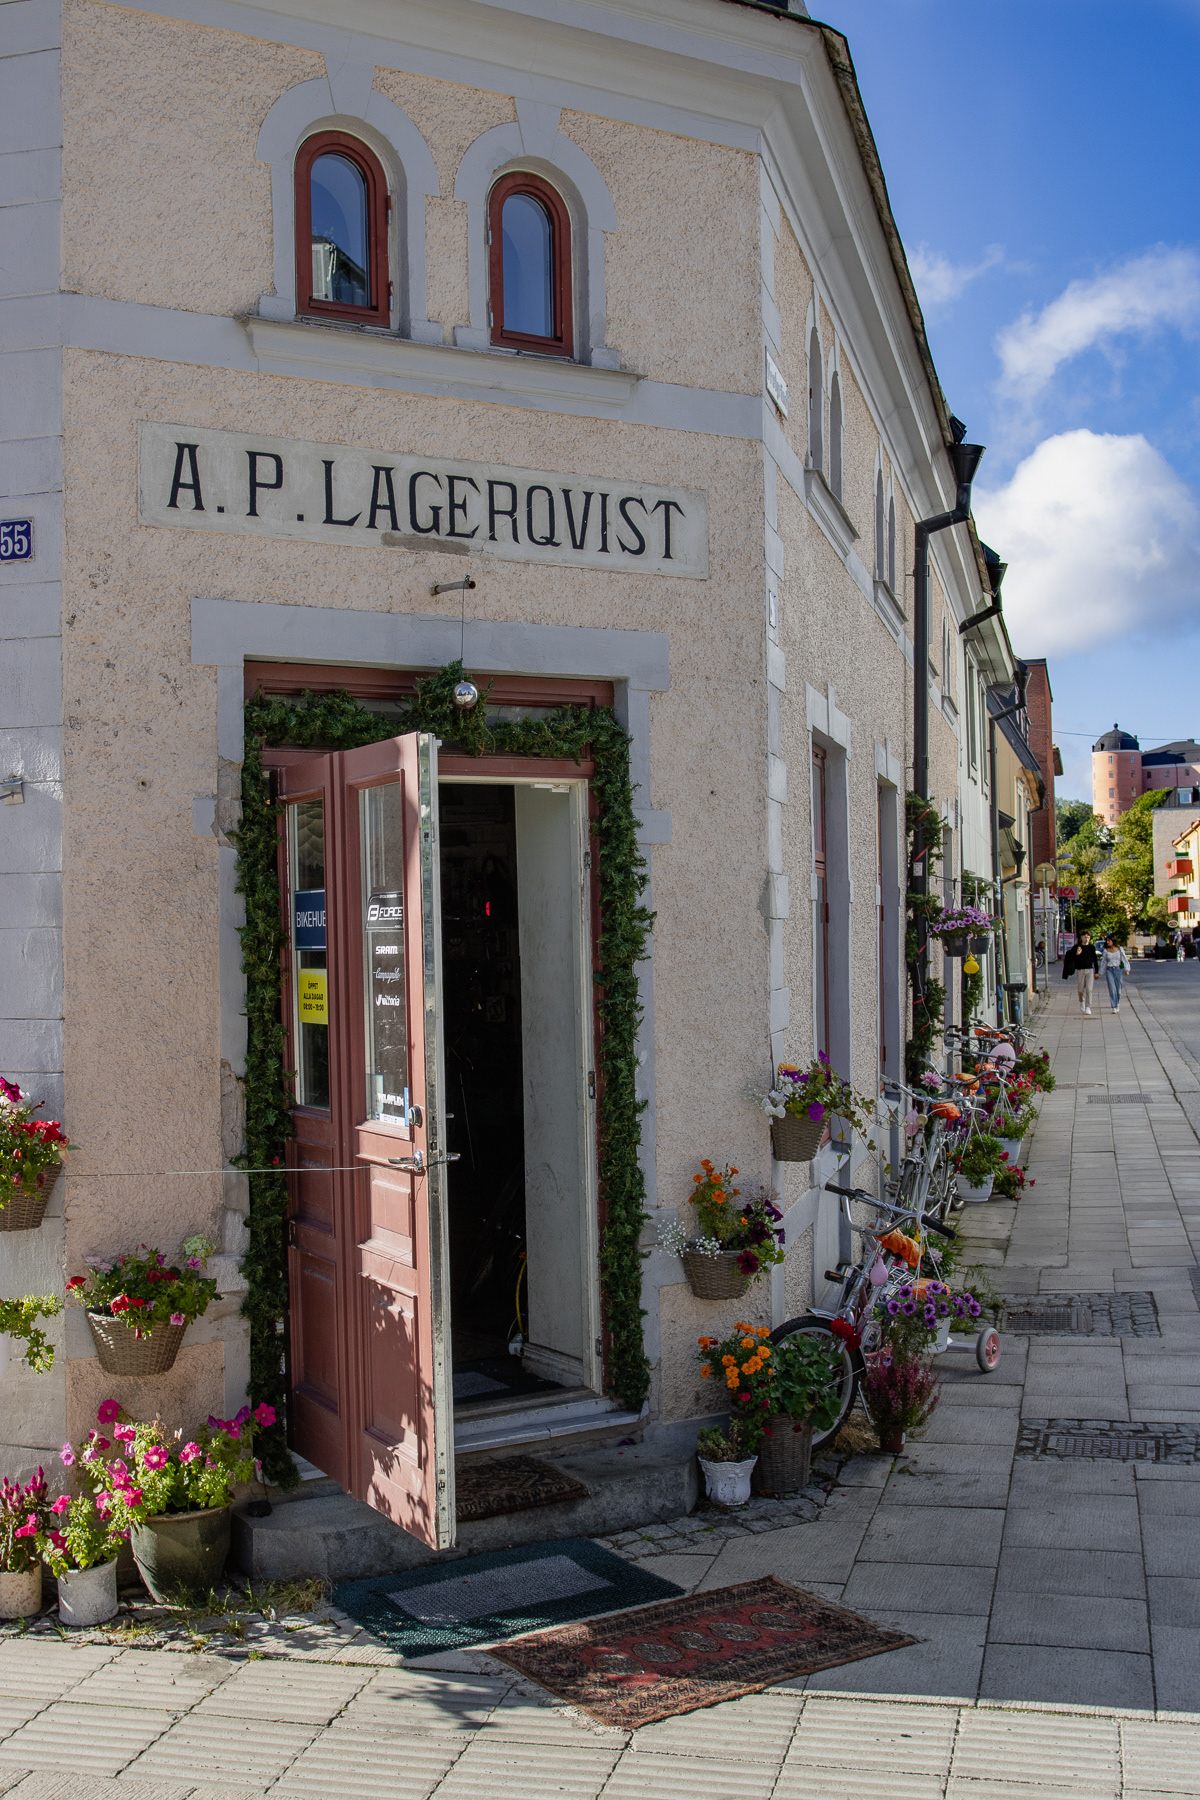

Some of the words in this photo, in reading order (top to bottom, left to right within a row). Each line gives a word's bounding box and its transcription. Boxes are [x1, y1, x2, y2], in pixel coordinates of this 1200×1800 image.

[322, 459, 687, 561] LAGERQVIST
[1, 524, 28, 557] 55
[1060, 888, 1075, 897] ICA
[375, 946, 398, 955] SRAM
